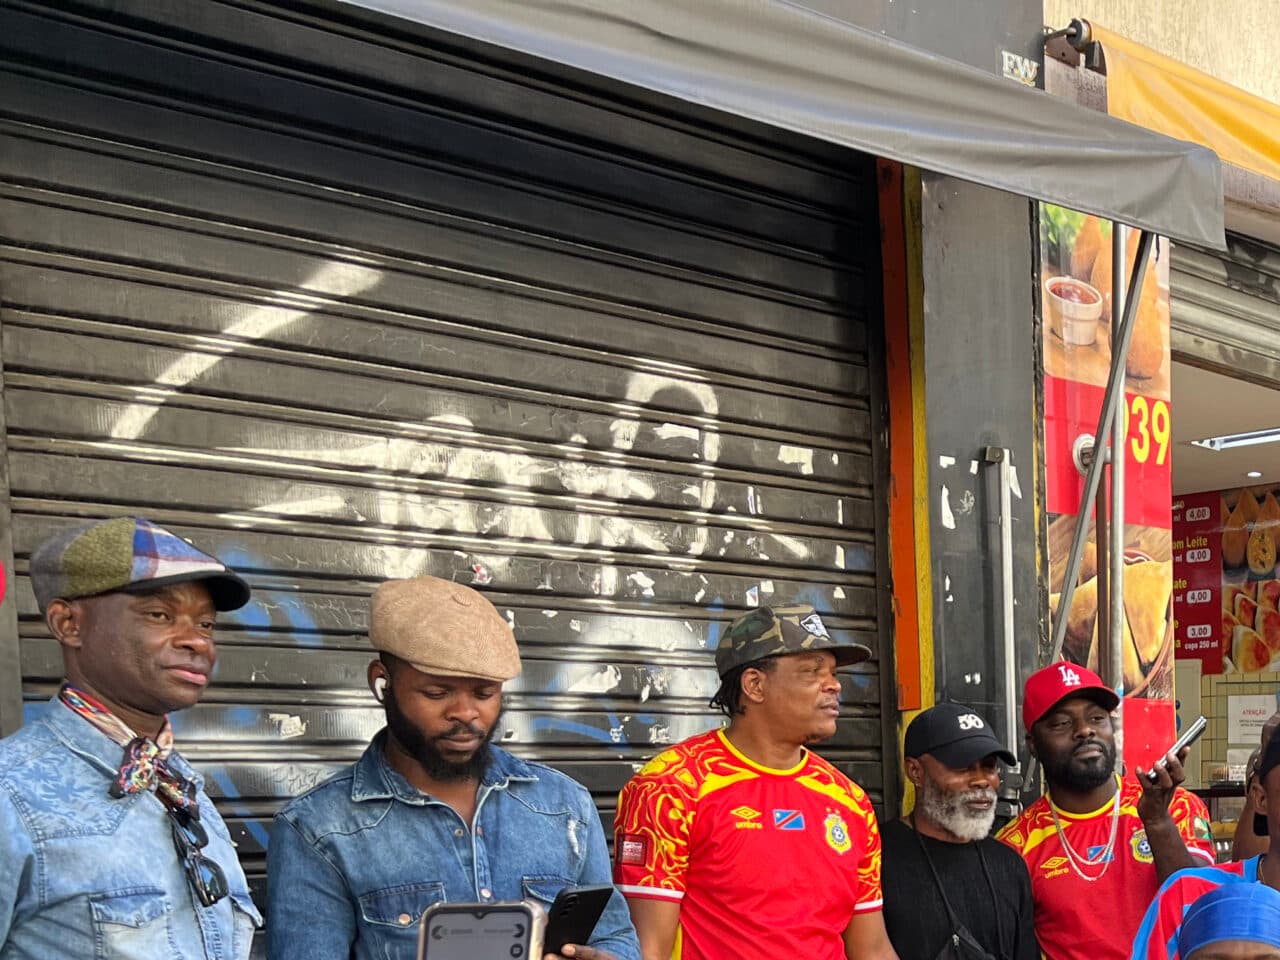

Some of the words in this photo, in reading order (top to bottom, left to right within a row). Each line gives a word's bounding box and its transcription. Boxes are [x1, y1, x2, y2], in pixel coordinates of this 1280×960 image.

[1190, 550, 1207, 561] 4,00
[1190, 591, 1207, 602] 4,00
[1058, 665, 1081, 687] LA
